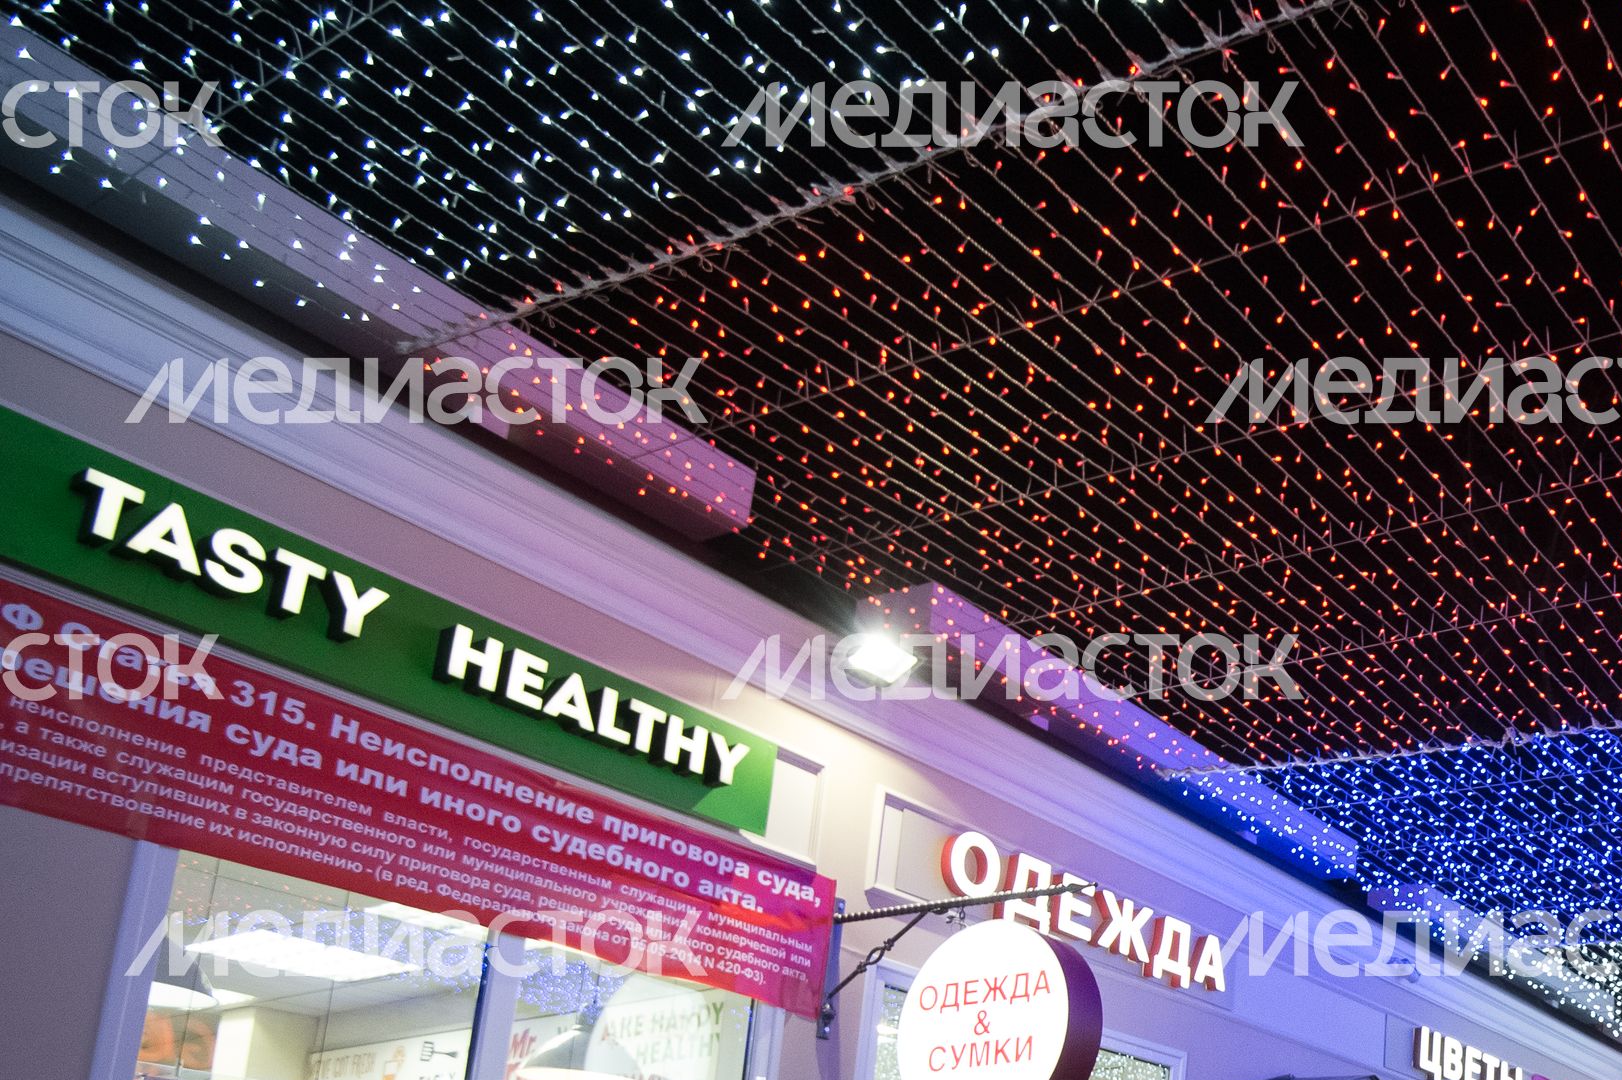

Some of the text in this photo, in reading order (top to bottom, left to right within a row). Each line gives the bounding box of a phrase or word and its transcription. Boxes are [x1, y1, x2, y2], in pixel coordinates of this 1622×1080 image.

[84, 467, 390, 640] TASTY
[60, 622, 217, 696] Статья
[229, 680, 315, 730] 315.
[330, 713, 595, 824] Неисполнение
[603, 813, 750, 879] приговора
[757, 869, 822, 908] суда,
[446, 624, 751, 787] HEALTHY
[9, 696, 813, 954] неисполнение представителем власти, государственным служащим, муниципальным
[15, 720, 30, 734] а
[39, 726, 108, 758] также
[115, 752, 235, 796] служащим
[241, 788, 417, 849] государственного
[422, 842, 456, 861] или
[462, 856, 597, 904] муниципального
[697, 924, 787, 960] коммерческой
[790, 953, 811, 968] или
[92, 763, 230, 816] вступивших
[234, 806, 248, 820] в
[251, 812, 348, 850] законную
[351, 841, 396, 866] силу
[399, 855, 491, 891] приговора
[494, 881, 534, 904] суда,
[538, 895, 606, 923] решения
[607, 916, 642, 934] суда
[645, 925, 671, 941] или
[674, 933, 714, 954] иного
[717, 946, 780, 974] судебного
[209, 821, 234, 839] их
[237, 829, 363, 873] исполнению
[396, 873, 433, 894] ред.
[436, 883, 557, 928] Федерального
[559, 919, 610, 942] закона
[611, 934, 630, 946] от
[225, 723, 323, 769] суда
[335, 758, 408, 798] или
[419, 786, 522, 833] иного
[531, 823, 690, 888] судебного
[698, 879, 764, 914] акта.
[919, 970, 1051, 1014] ОДЕЖДА
[946, 831, 1226, 992] ОДЕЖДА
[929, 1035, 1033, 1072] СУМКИ
[973, 1010, 991, 1036] &
